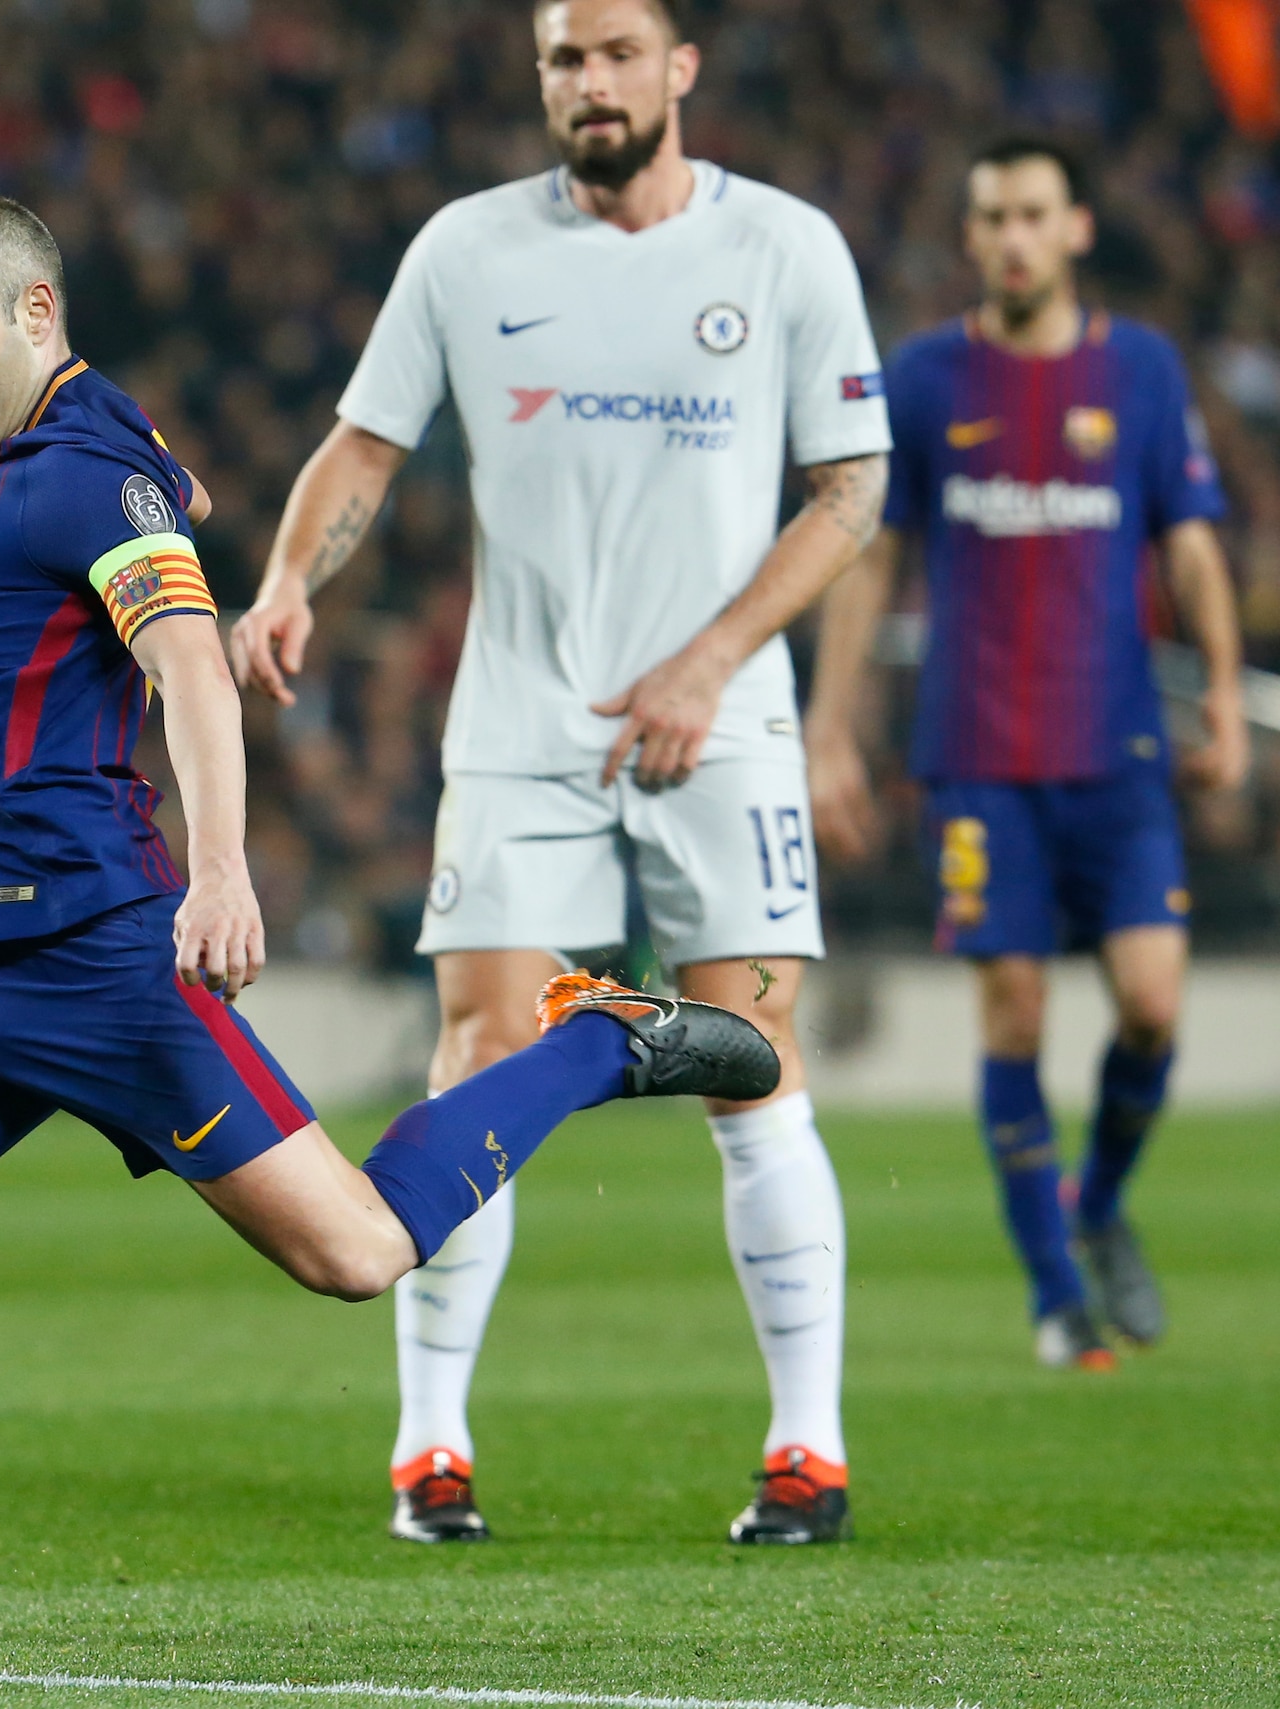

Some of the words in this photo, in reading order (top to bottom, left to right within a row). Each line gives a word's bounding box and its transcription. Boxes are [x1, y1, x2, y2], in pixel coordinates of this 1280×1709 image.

[561, 393, 735, 421] YOKOHAMA
[146, 505, 161, 521] 5
[747, 807, 807, 890] 18
